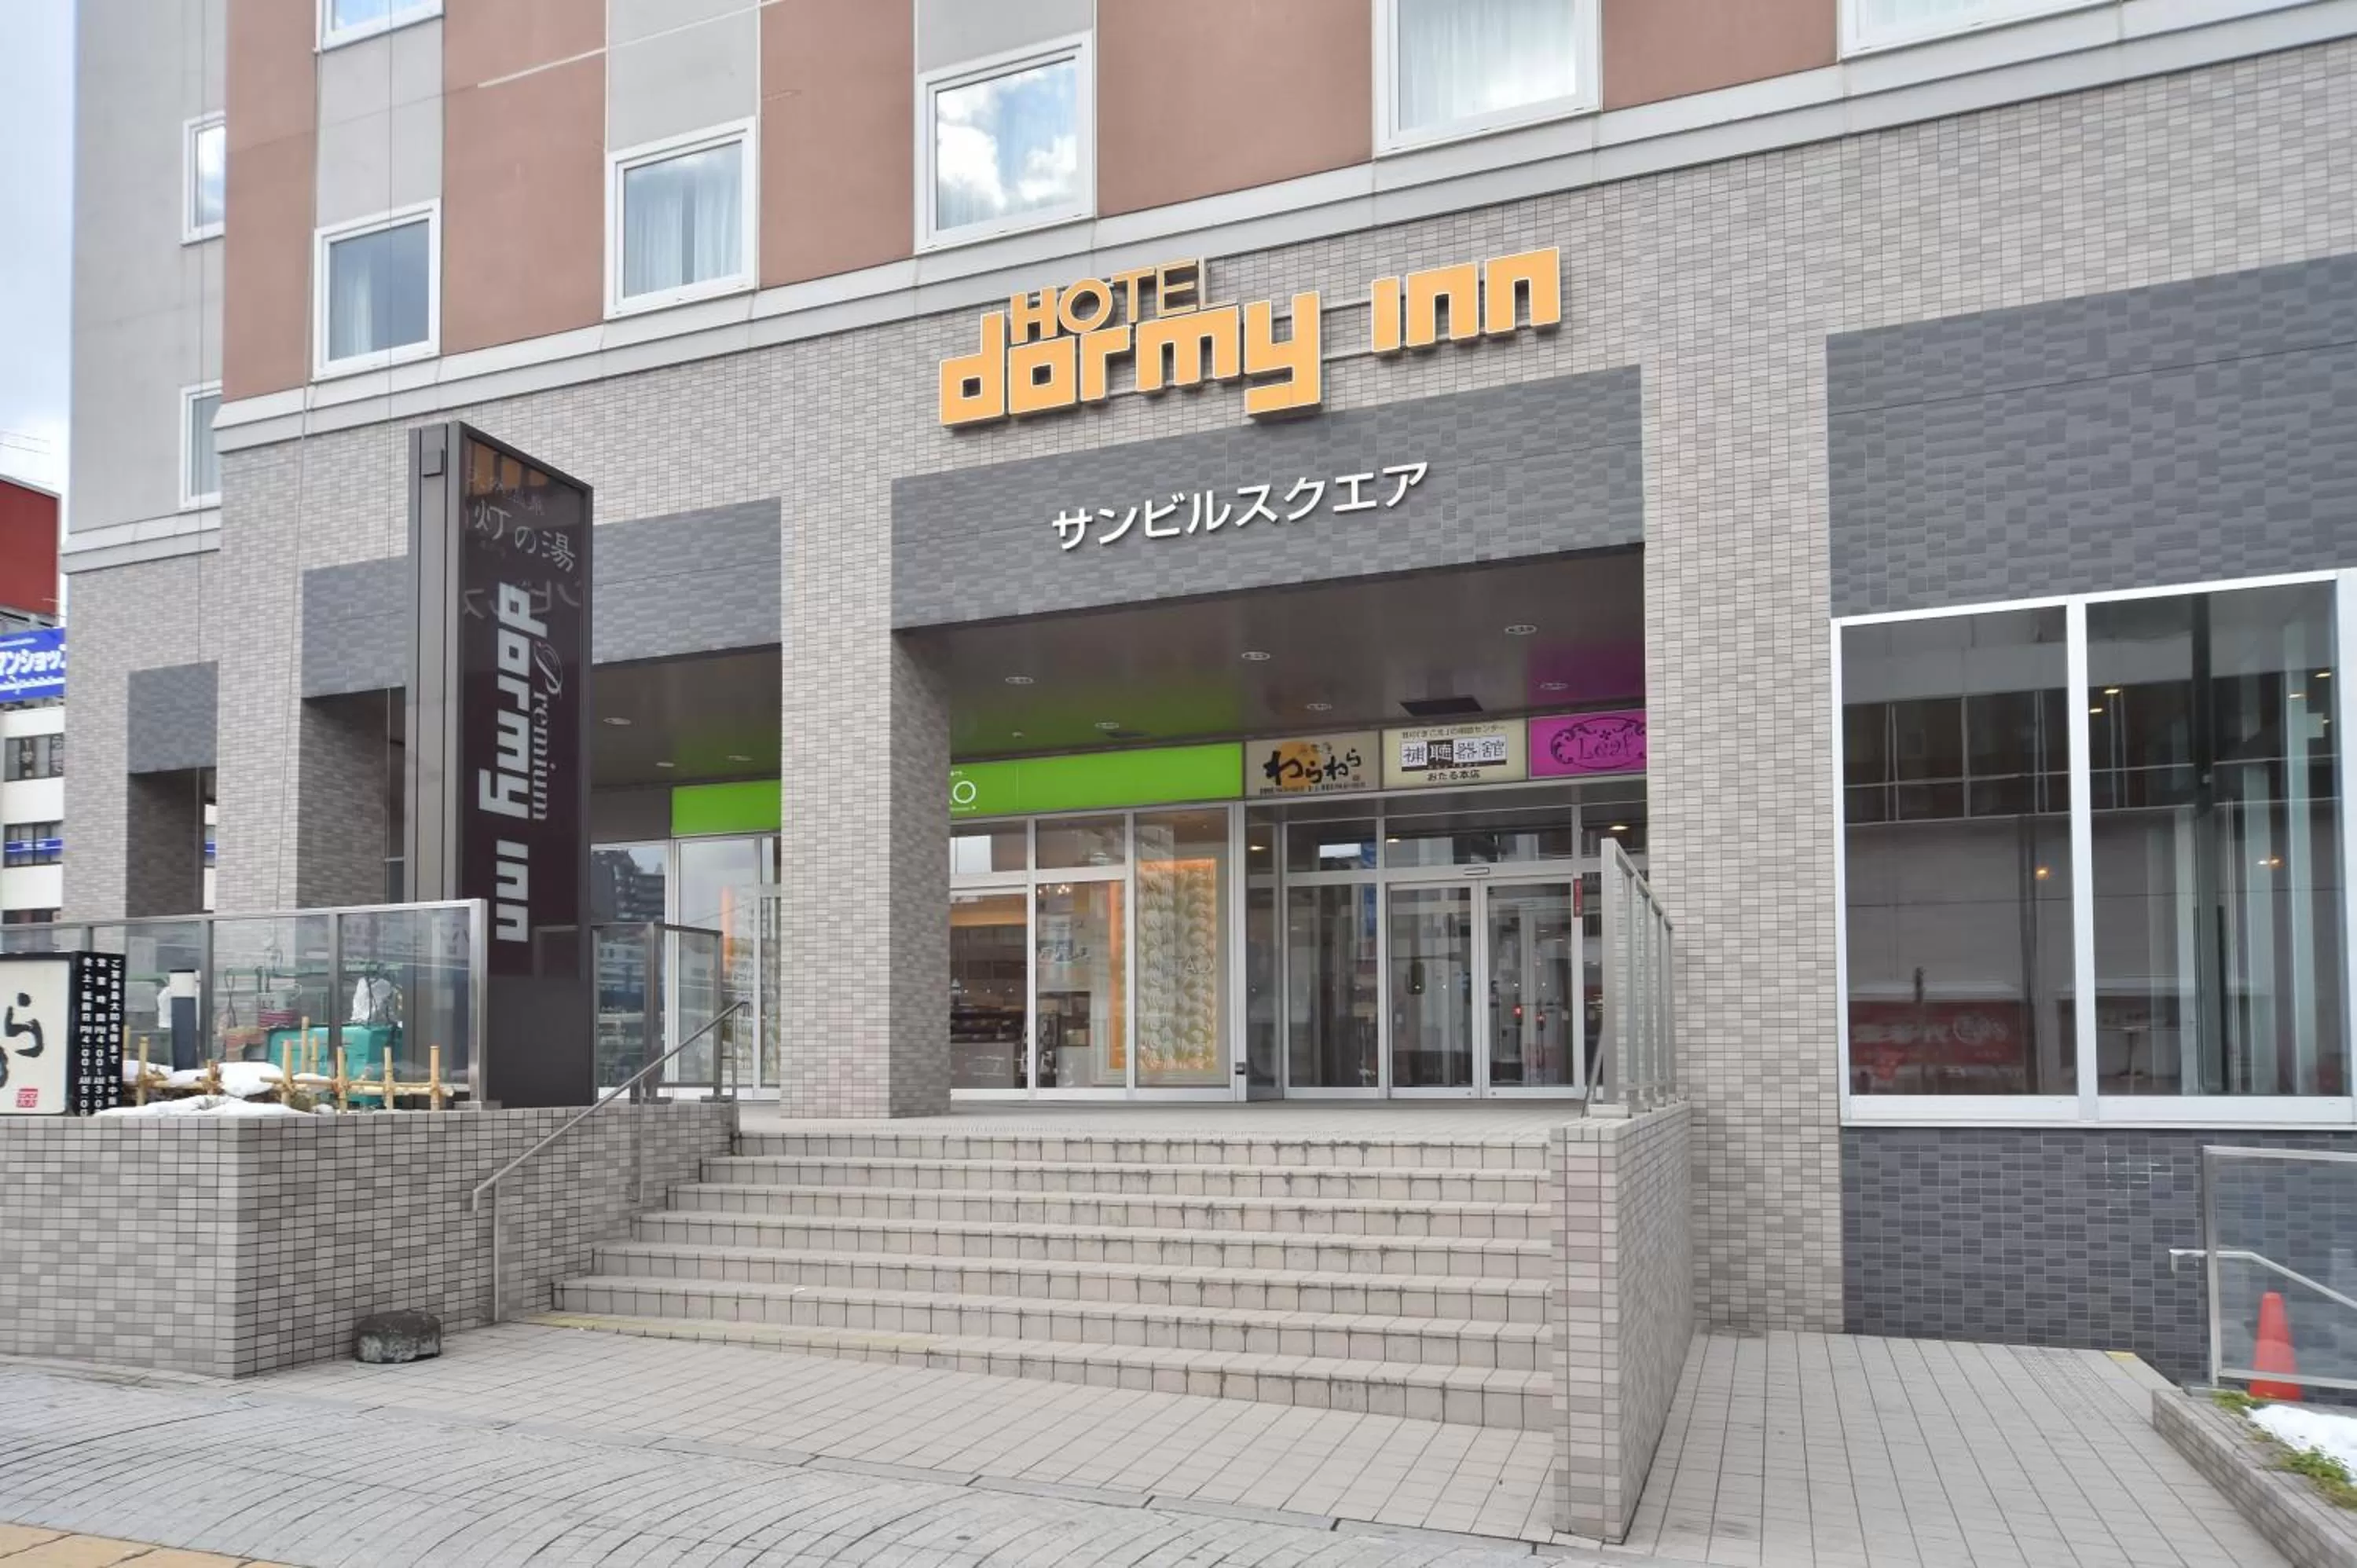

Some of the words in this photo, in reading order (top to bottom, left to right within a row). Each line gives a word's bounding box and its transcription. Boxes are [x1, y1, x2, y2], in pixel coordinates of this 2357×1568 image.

[940, 291, 1321, 428] dormy
[1372, 247, 1561, 354] inn
[1010, 257, 1237, 344] HOTEL
[475, 499, 576, 572] 灯の湯
[1051, 461, 1428, 551] サンビルスクエア
[478, 581, 548, 820] dormy
[1263, 748, 1362, 786] わらわら
[1403, 738, 1505, 764] 補聴器館
[1427, 769, 1481, 782] おたる本店
[496, 839, 530, 943] inn
